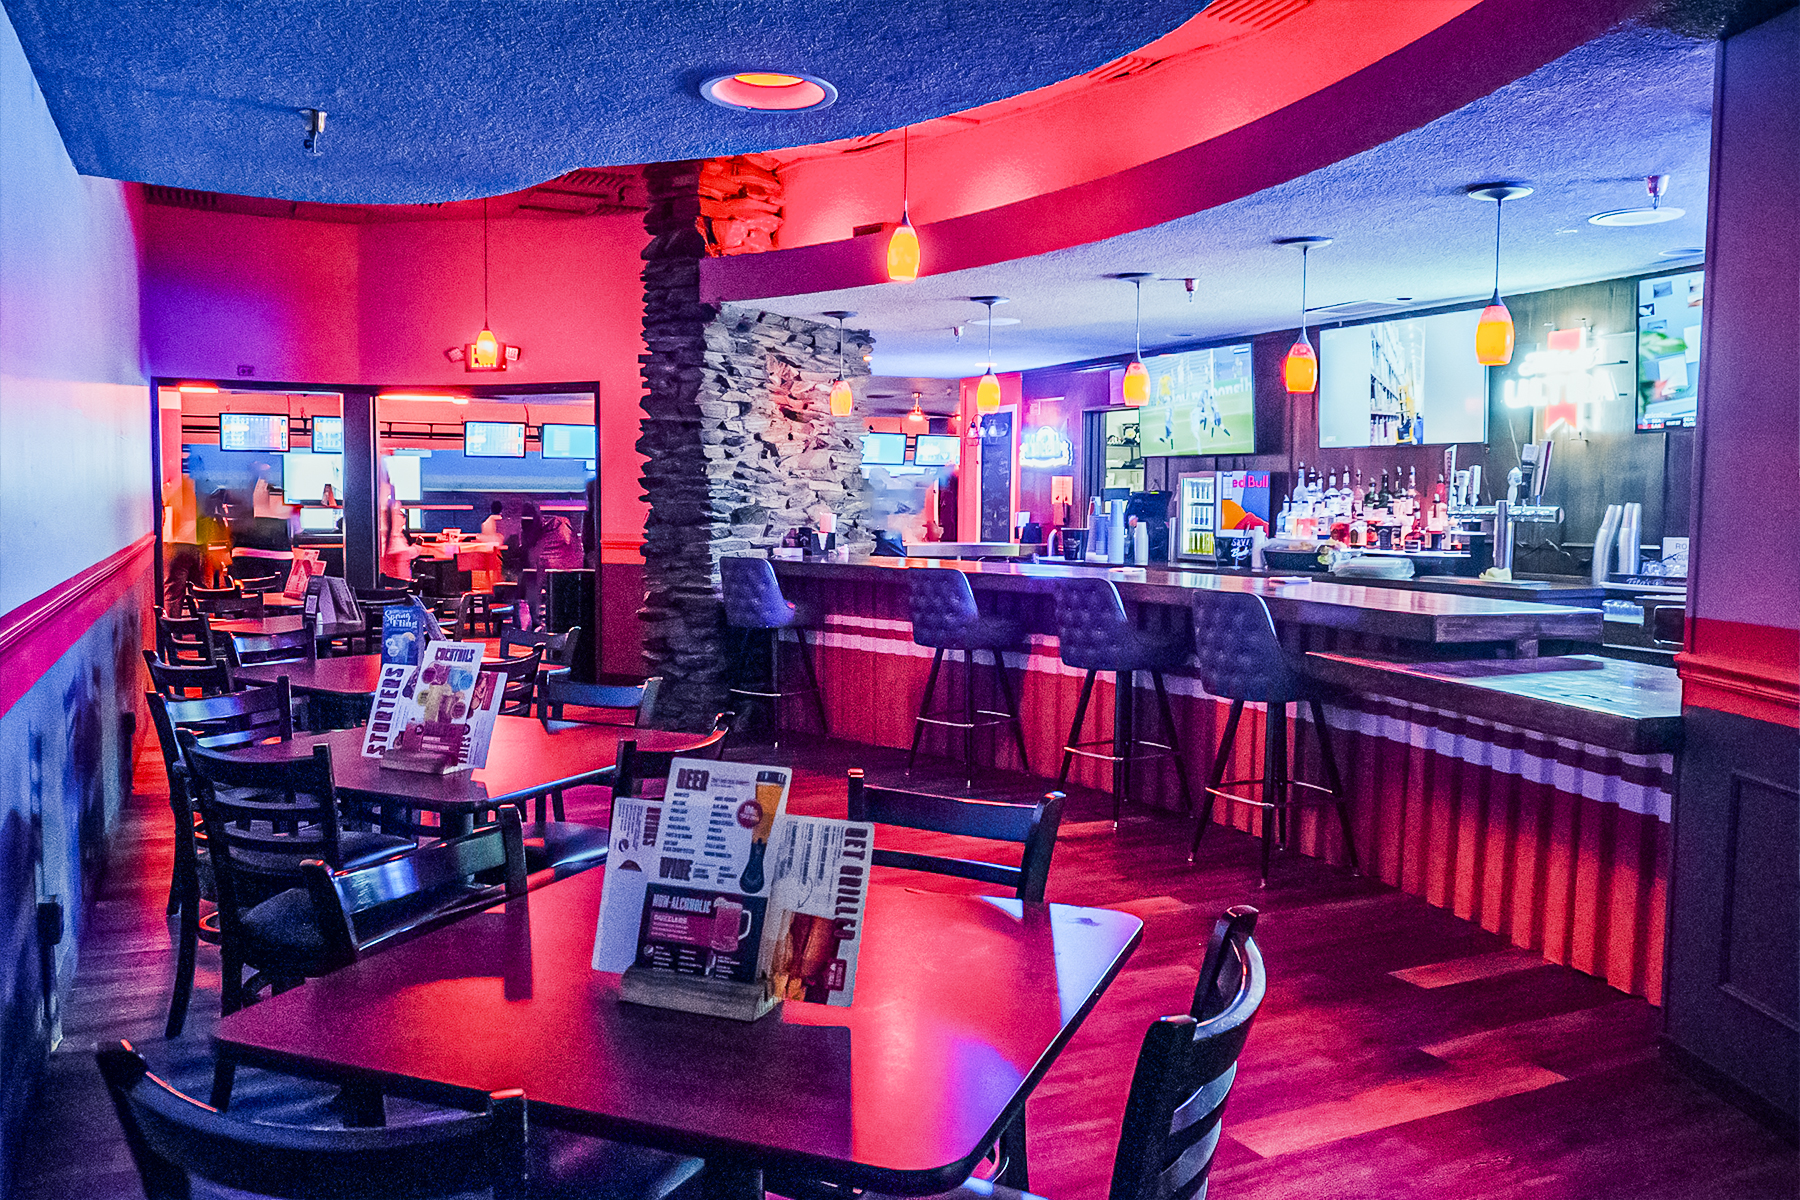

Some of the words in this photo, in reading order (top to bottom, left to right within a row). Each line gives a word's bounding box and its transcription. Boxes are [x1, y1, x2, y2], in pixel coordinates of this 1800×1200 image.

[1232, 475, 1246, 488] ed
[1247, 475, 1269, 488] Bull
[384, 610, 411, 625] Spring
[434, 647, 476, 663] COCKTAILS
[366, 667, 405, 756] STARTERS
[676, 768, 710, 792] BEER
[642, 806, 662, 847] DRINKS
[842, 827, 868, 861] GET
[659, 856, 694, 882] WINE
[652, 893, 712, 914] NON-ALCOHOLIC
[834, 865, 864, 941] GRILLED
